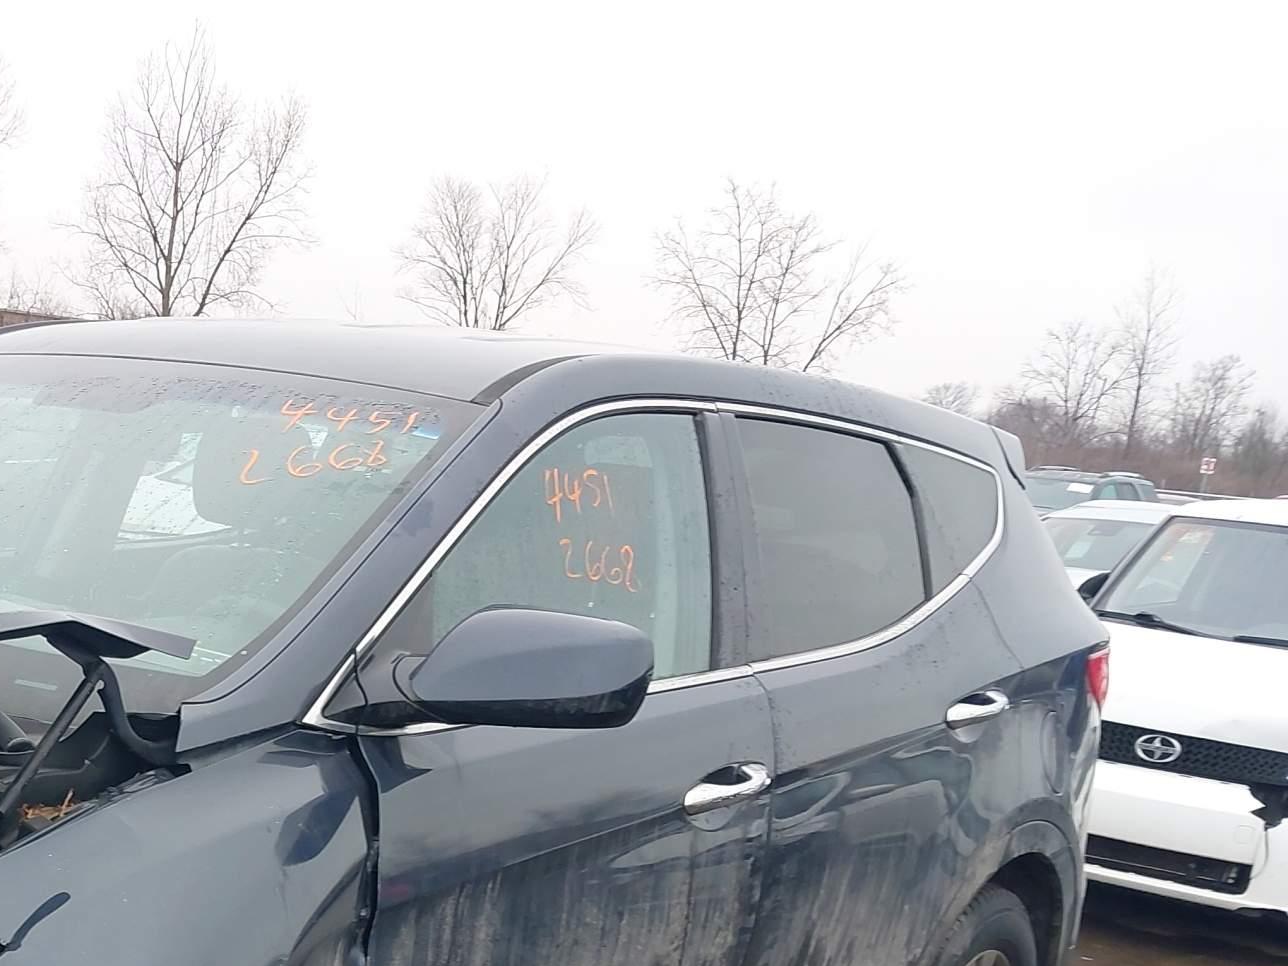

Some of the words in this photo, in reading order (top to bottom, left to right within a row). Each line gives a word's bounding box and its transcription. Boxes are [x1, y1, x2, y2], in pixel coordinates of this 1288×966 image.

[280, 398, 420, 435] 4451
[239, 439, 388, 485] 2668
[544, 468, 615, 523] 4451
